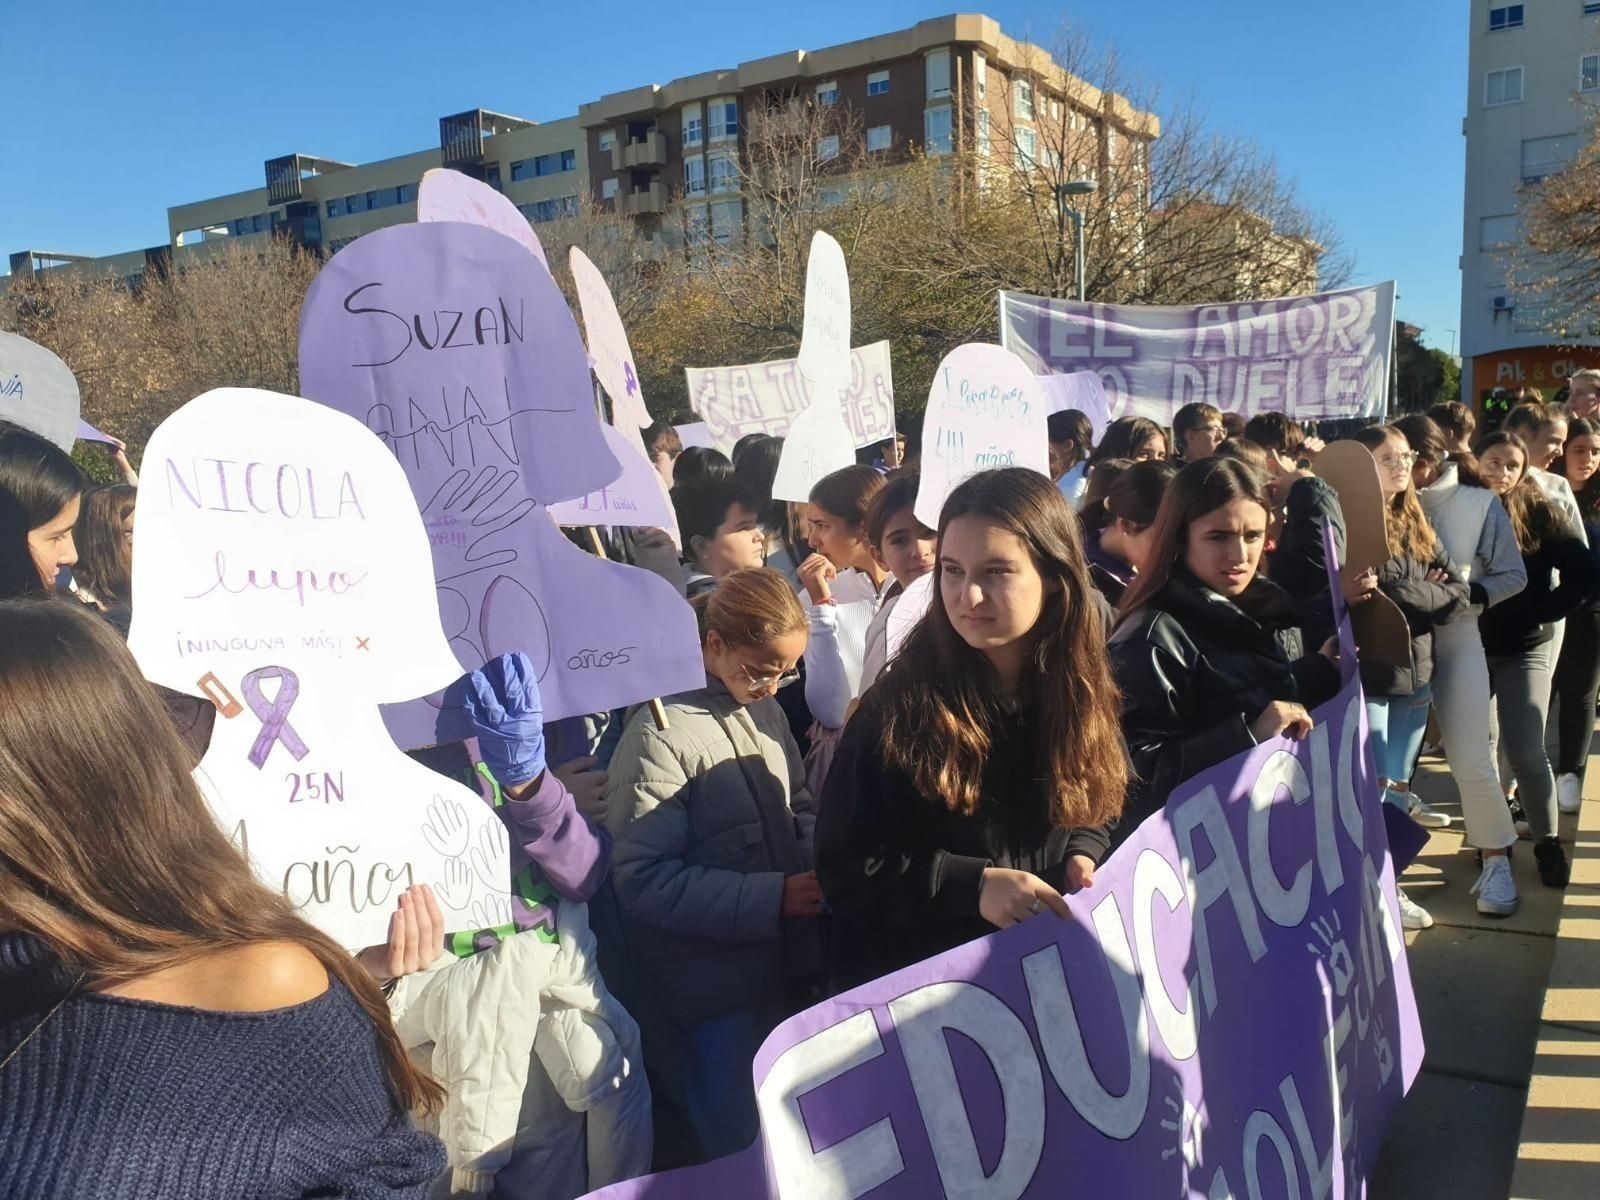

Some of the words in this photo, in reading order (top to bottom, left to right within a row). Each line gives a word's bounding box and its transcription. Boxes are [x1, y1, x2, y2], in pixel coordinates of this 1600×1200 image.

[344, 282, 525, 367] SUZAN
[1049, 302, 1133, 358] EL
[1192, 294, 1363, 358] AMOR
[1172, 356, 1364, 418] DUELE
[166, 457, 366, 520] NICOLA
[176, 630, 286, 657] ¡NINGUNA
[567, 646, 638, 671] años
[285, 770, 345, 804] 25N
